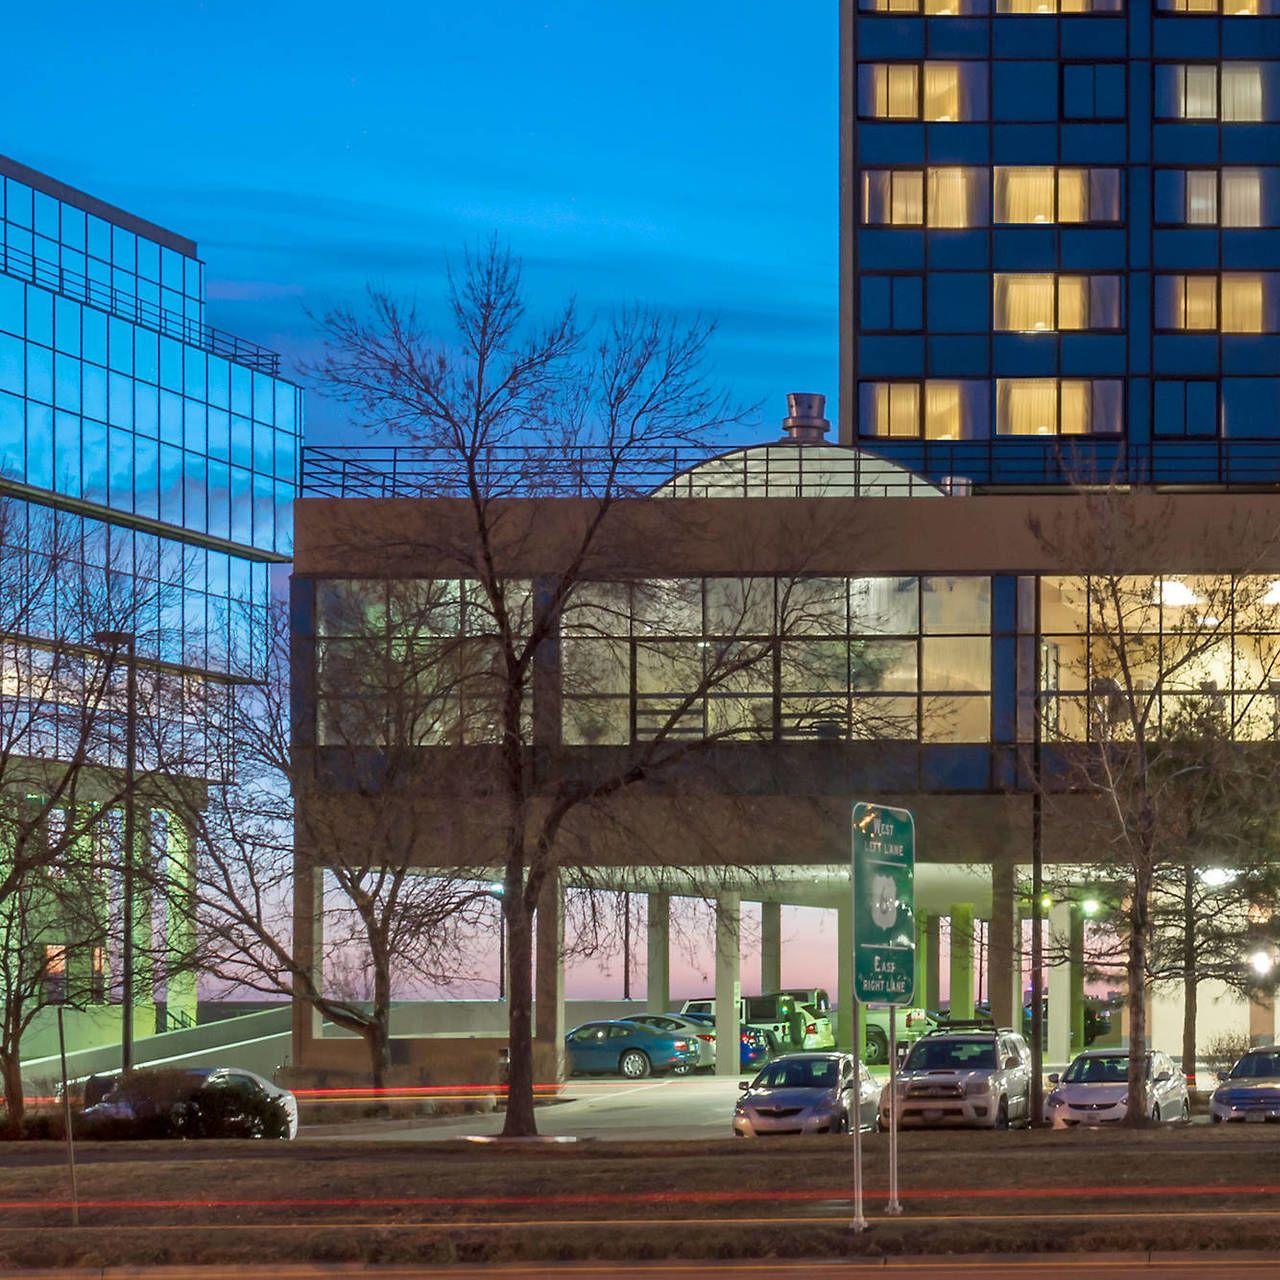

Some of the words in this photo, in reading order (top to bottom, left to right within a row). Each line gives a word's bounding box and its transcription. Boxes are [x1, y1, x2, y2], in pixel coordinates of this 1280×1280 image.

[884, 843, 904, 856] LANE
[863, 979, 885, 992] RIGHT
[886, 980, 906, 993] LANE
